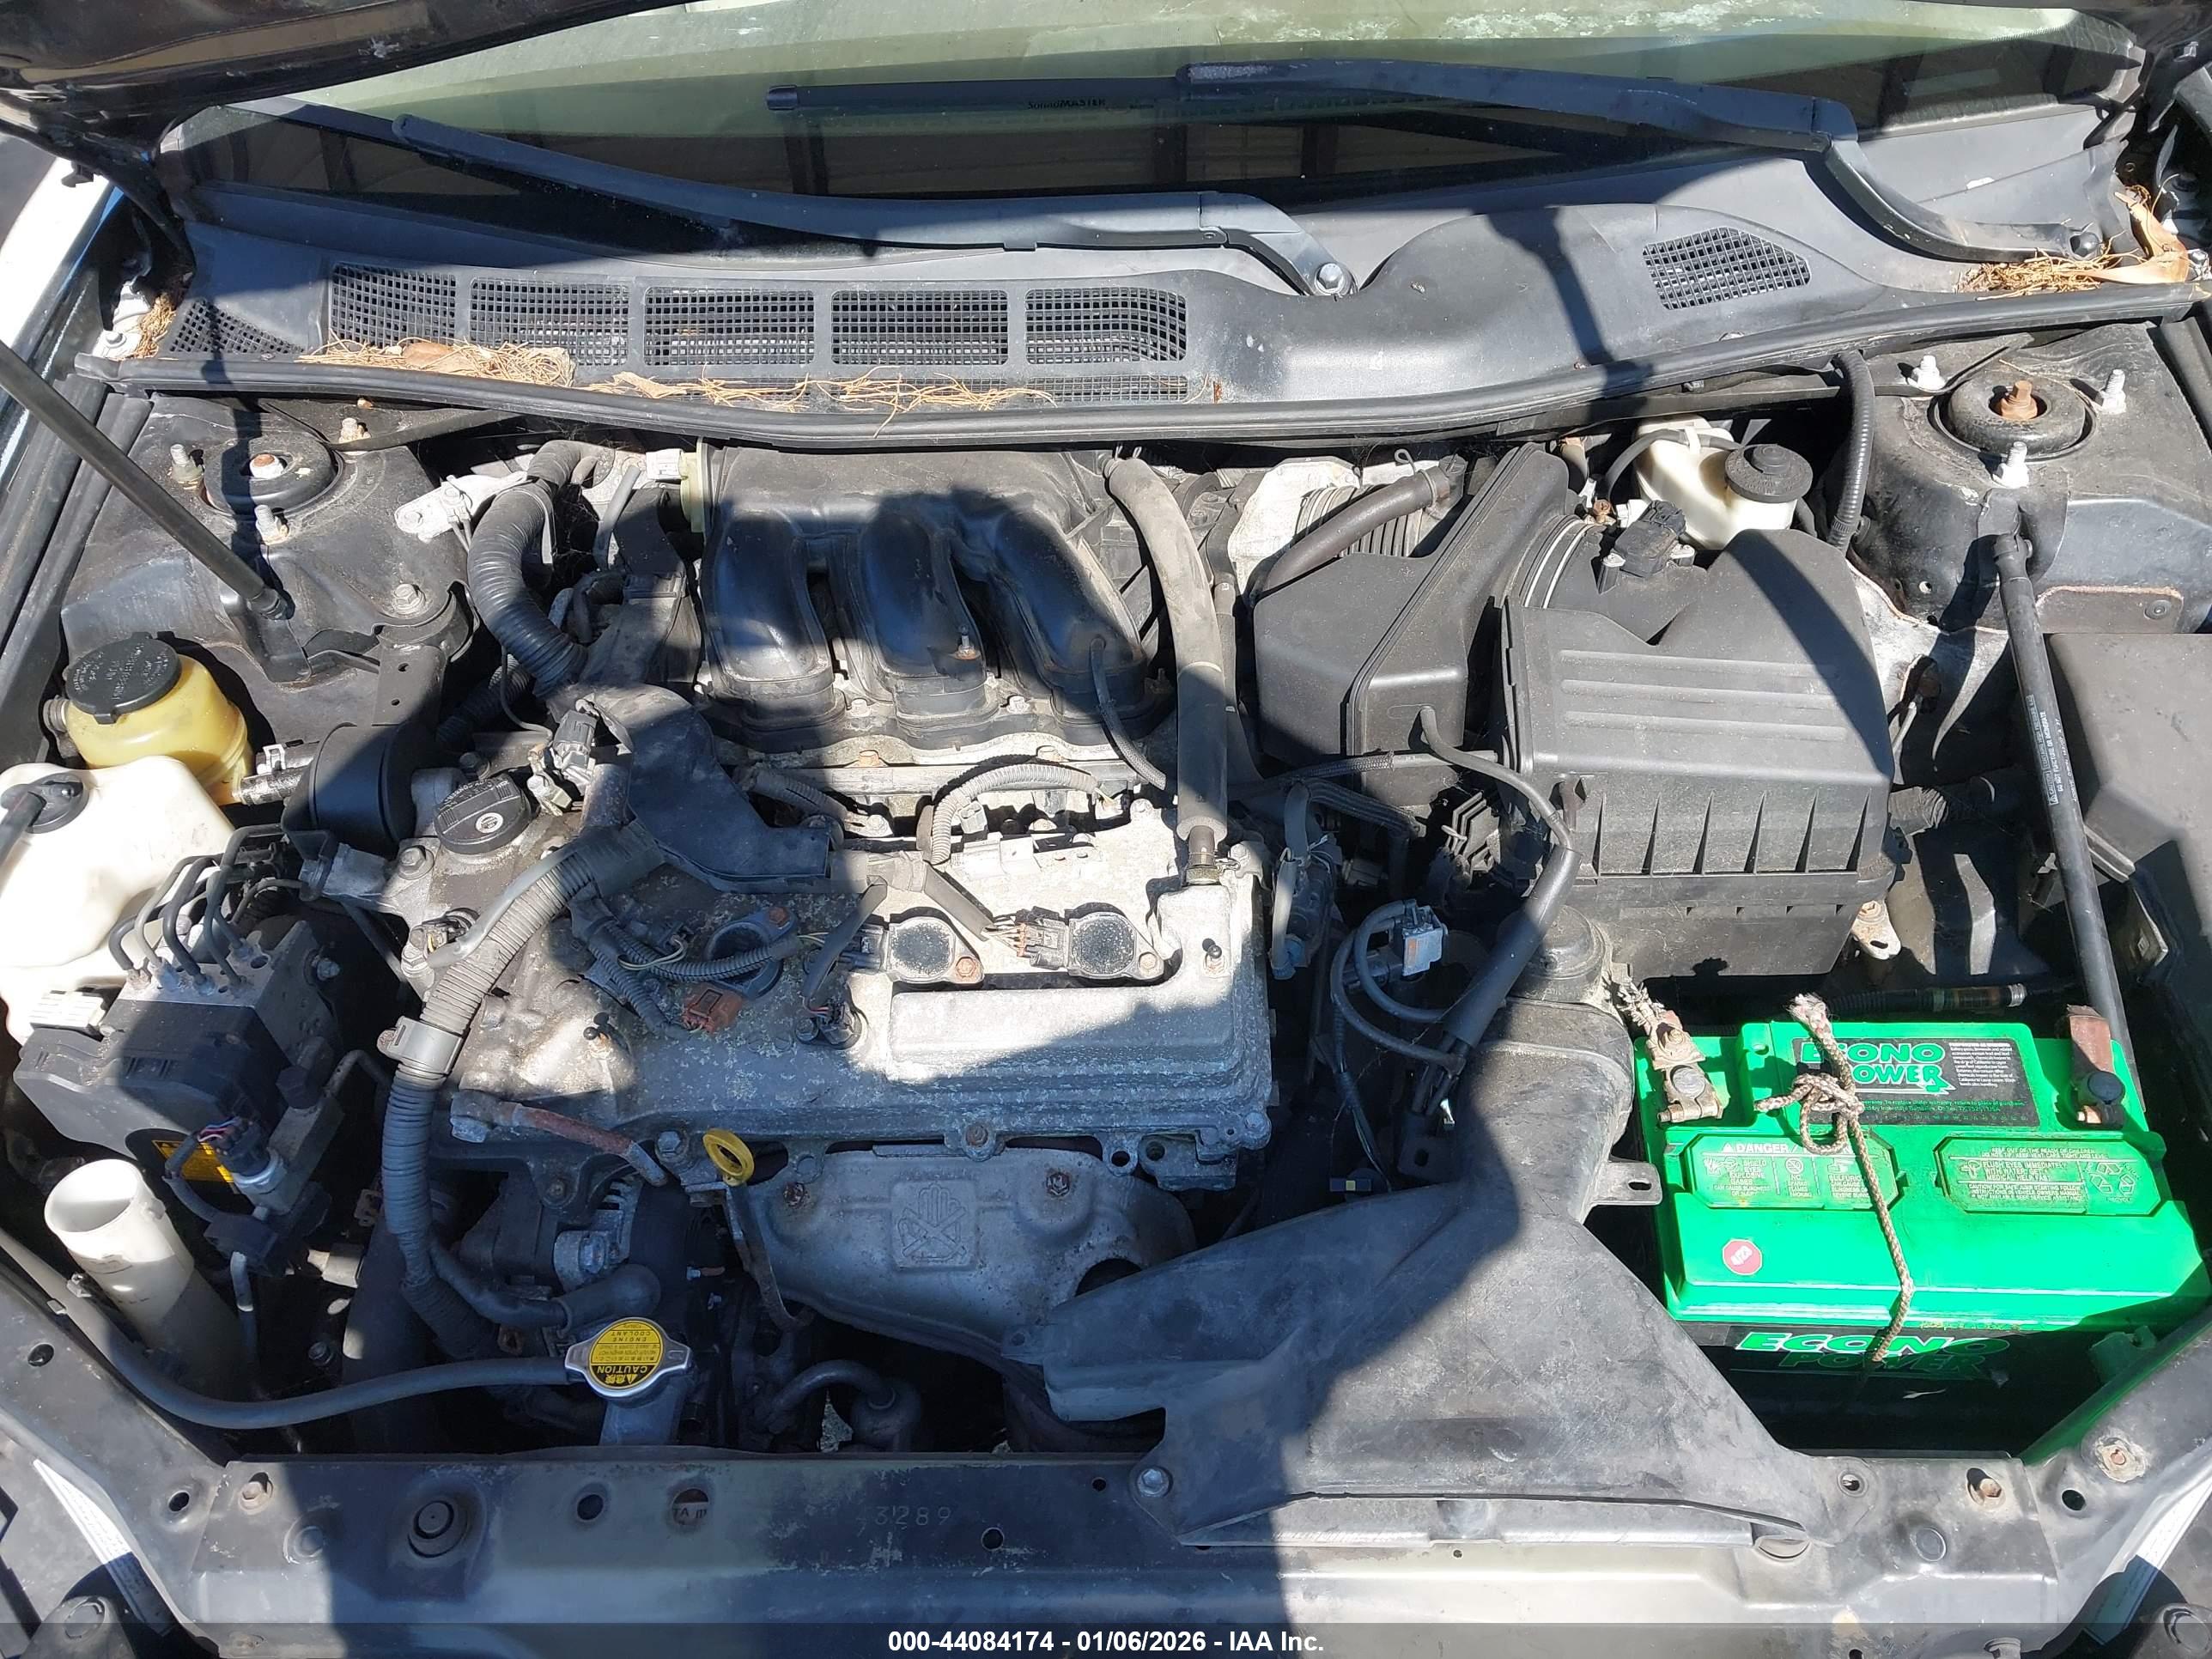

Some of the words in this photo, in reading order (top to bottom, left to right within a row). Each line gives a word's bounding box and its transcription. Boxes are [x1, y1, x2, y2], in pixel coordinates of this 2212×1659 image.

[1801, 1042, 1945, 1064] EONO
[1852, 1064, 1949, 1091] OWER
[1735, 1143, 1789, 1153] DANGER
[597, 1365, 647, 1374] CAUTION
